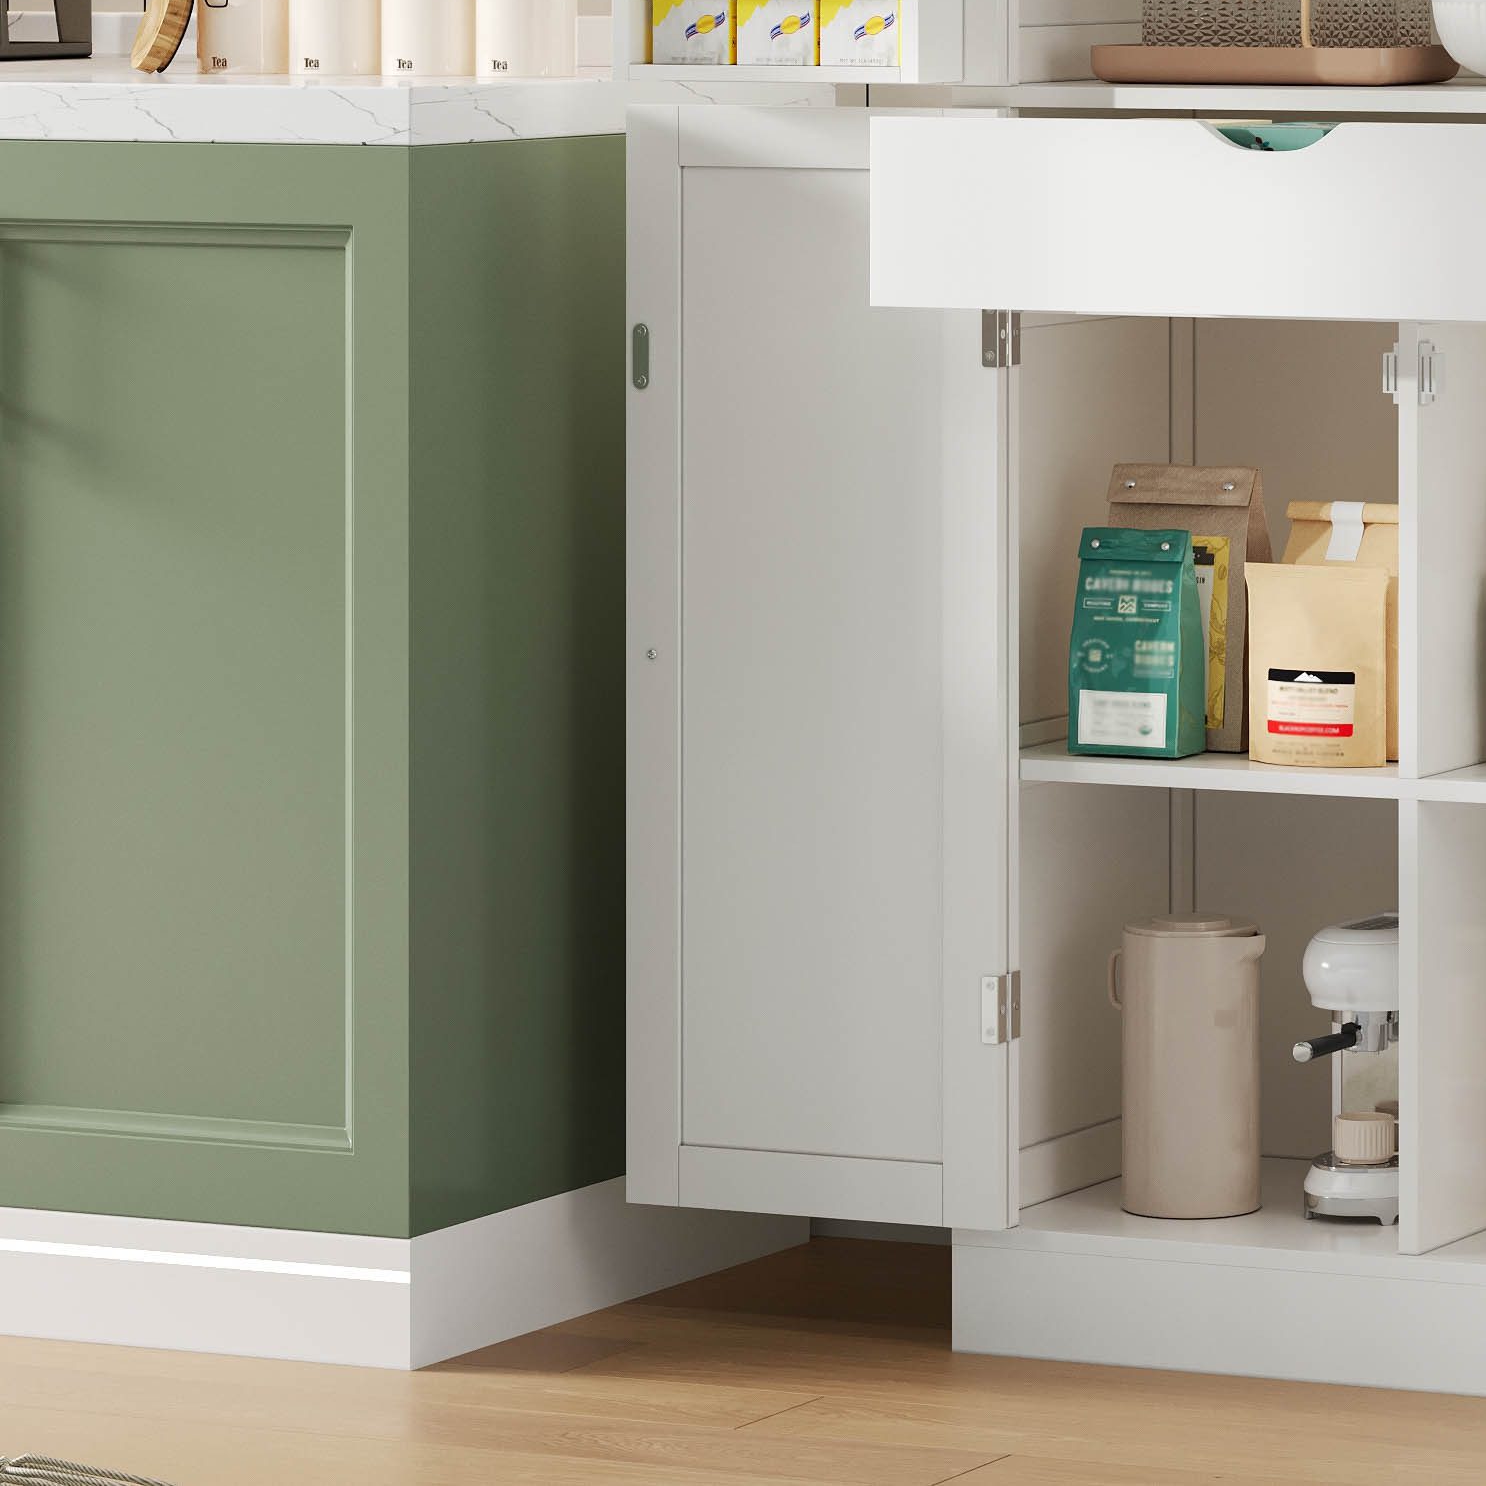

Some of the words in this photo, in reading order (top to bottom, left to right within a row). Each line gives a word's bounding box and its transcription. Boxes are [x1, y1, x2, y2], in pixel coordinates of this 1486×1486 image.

[211, 56, 228, 68] Tea
[303, 57, 320, 68] Tea
[396, 58, 413, 69] Tea
[491, 59, 508, 70] Tea
